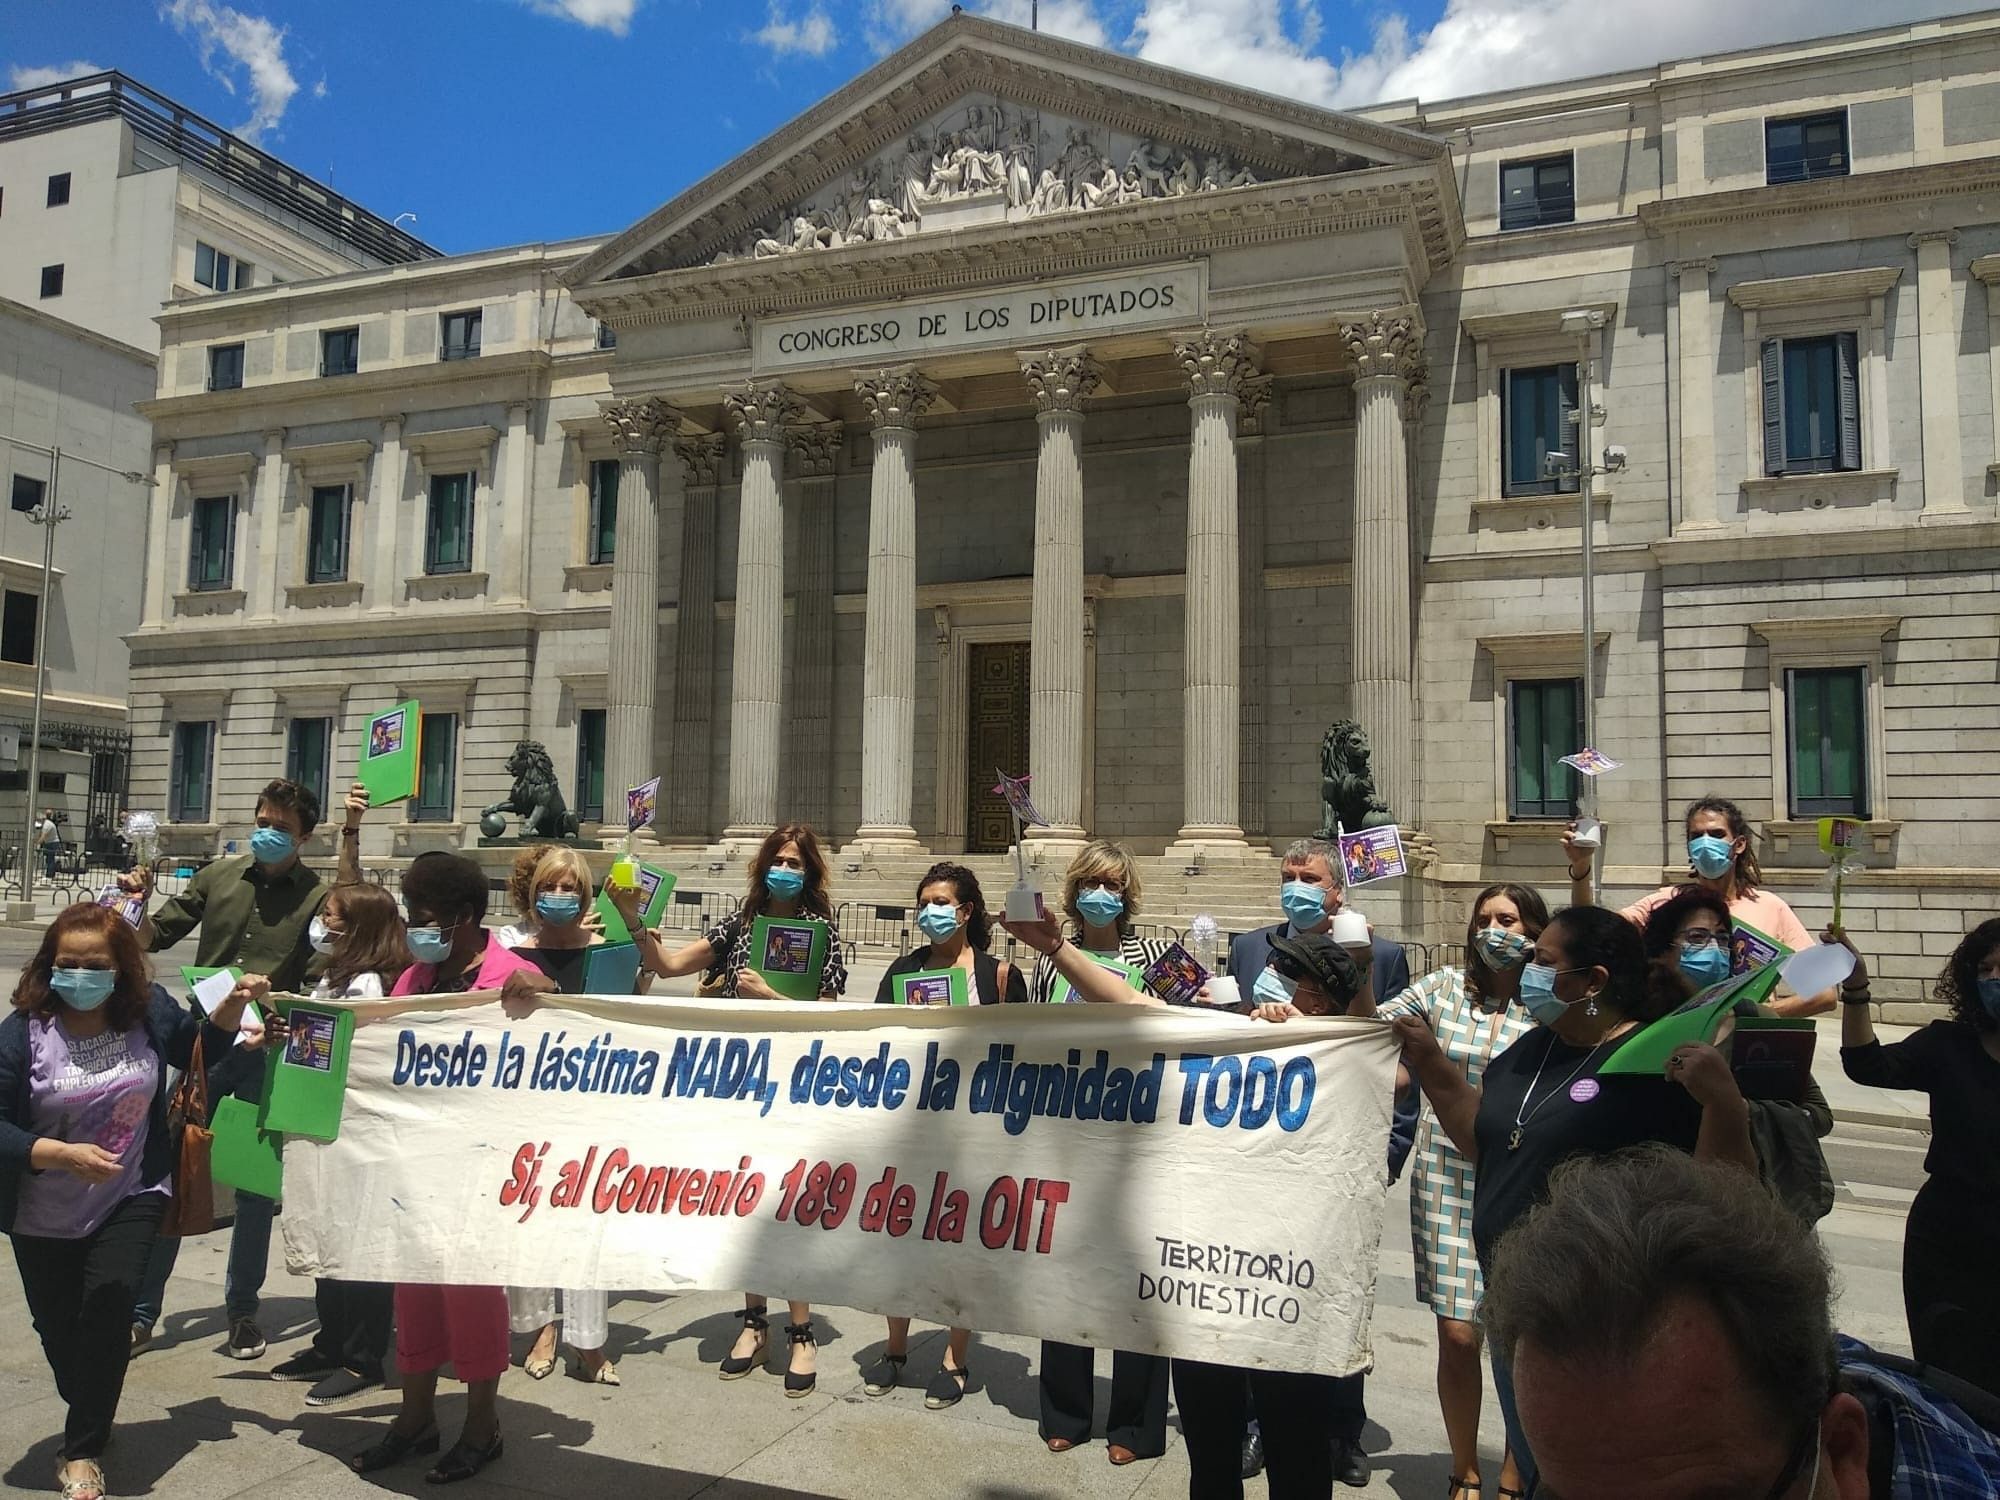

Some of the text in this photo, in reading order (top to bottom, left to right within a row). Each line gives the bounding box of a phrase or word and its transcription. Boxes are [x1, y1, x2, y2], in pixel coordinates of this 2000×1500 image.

[779, 285, 1174, 354] CONGRESO DE LOS DIPUTADOS
[392, 1030, 487, 1088] Desde
[492, 1032, 526, 1090] la
[530, 1030, 661, 1095] lástima
[661, 1036, 778, 1118] NADA,
[789, 1038, 911, 1111] desde
[916, 1041, 960, 1115] la
[969, 1042, 1166, 1136] dignidad
[1177, 1052, 1317, 1132] TODO
[550, 1144, 598, 1209] al
[592, 1146, 766, 1218] Convenio
[775, 1158, 857, 1231] 189
[858, 1166, 917, 1238] de
[922, 1171, 970, 1244] la
[979, 1175, 1071, 1255] OIT
